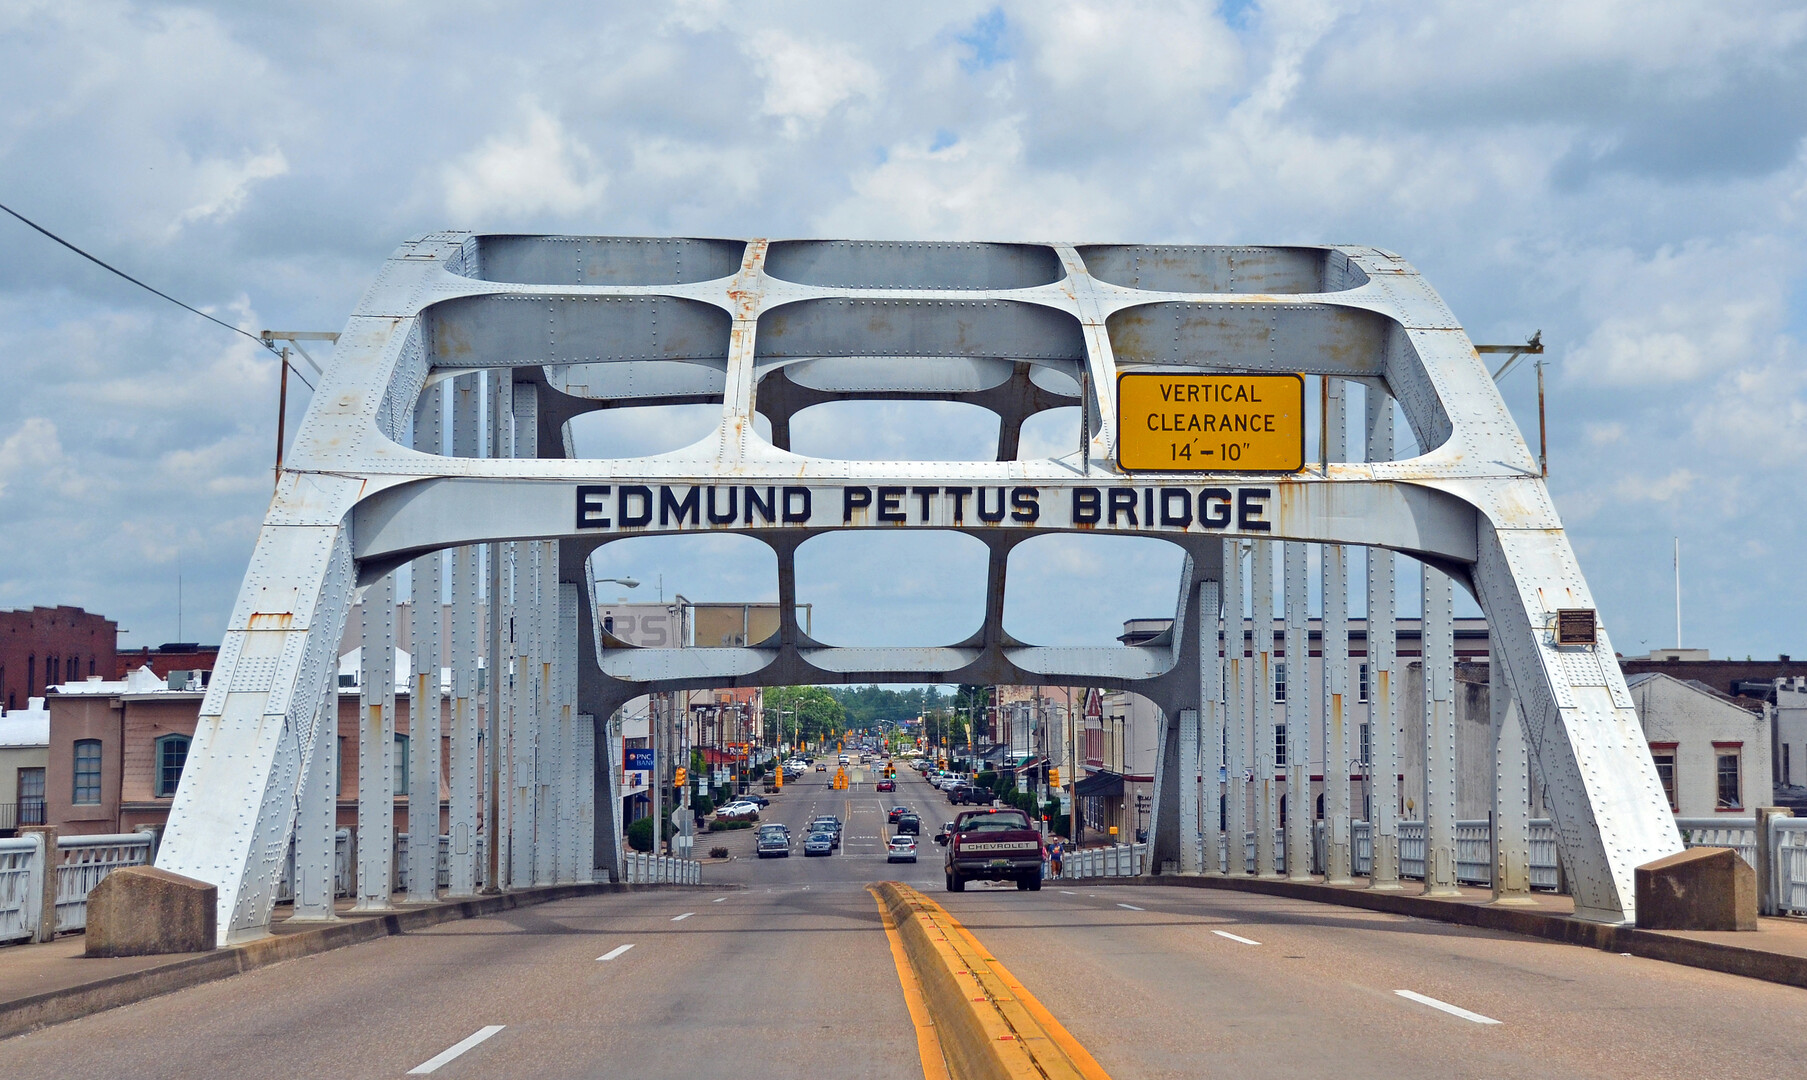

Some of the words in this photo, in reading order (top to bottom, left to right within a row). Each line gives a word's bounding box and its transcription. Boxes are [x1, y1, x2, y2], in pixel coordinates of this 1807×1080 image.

[1159, 384, 1262, 403] VERTICAL
[1147, 413, 1275, 432] CLEARANCE
[576, 485, 812, 529] EDMUND
[843, 485, 1041, 524] PETTUS
[1072, 487, 1272, 531] BRIDGE
[968, 842, 1030, 850] CHEVROLET
